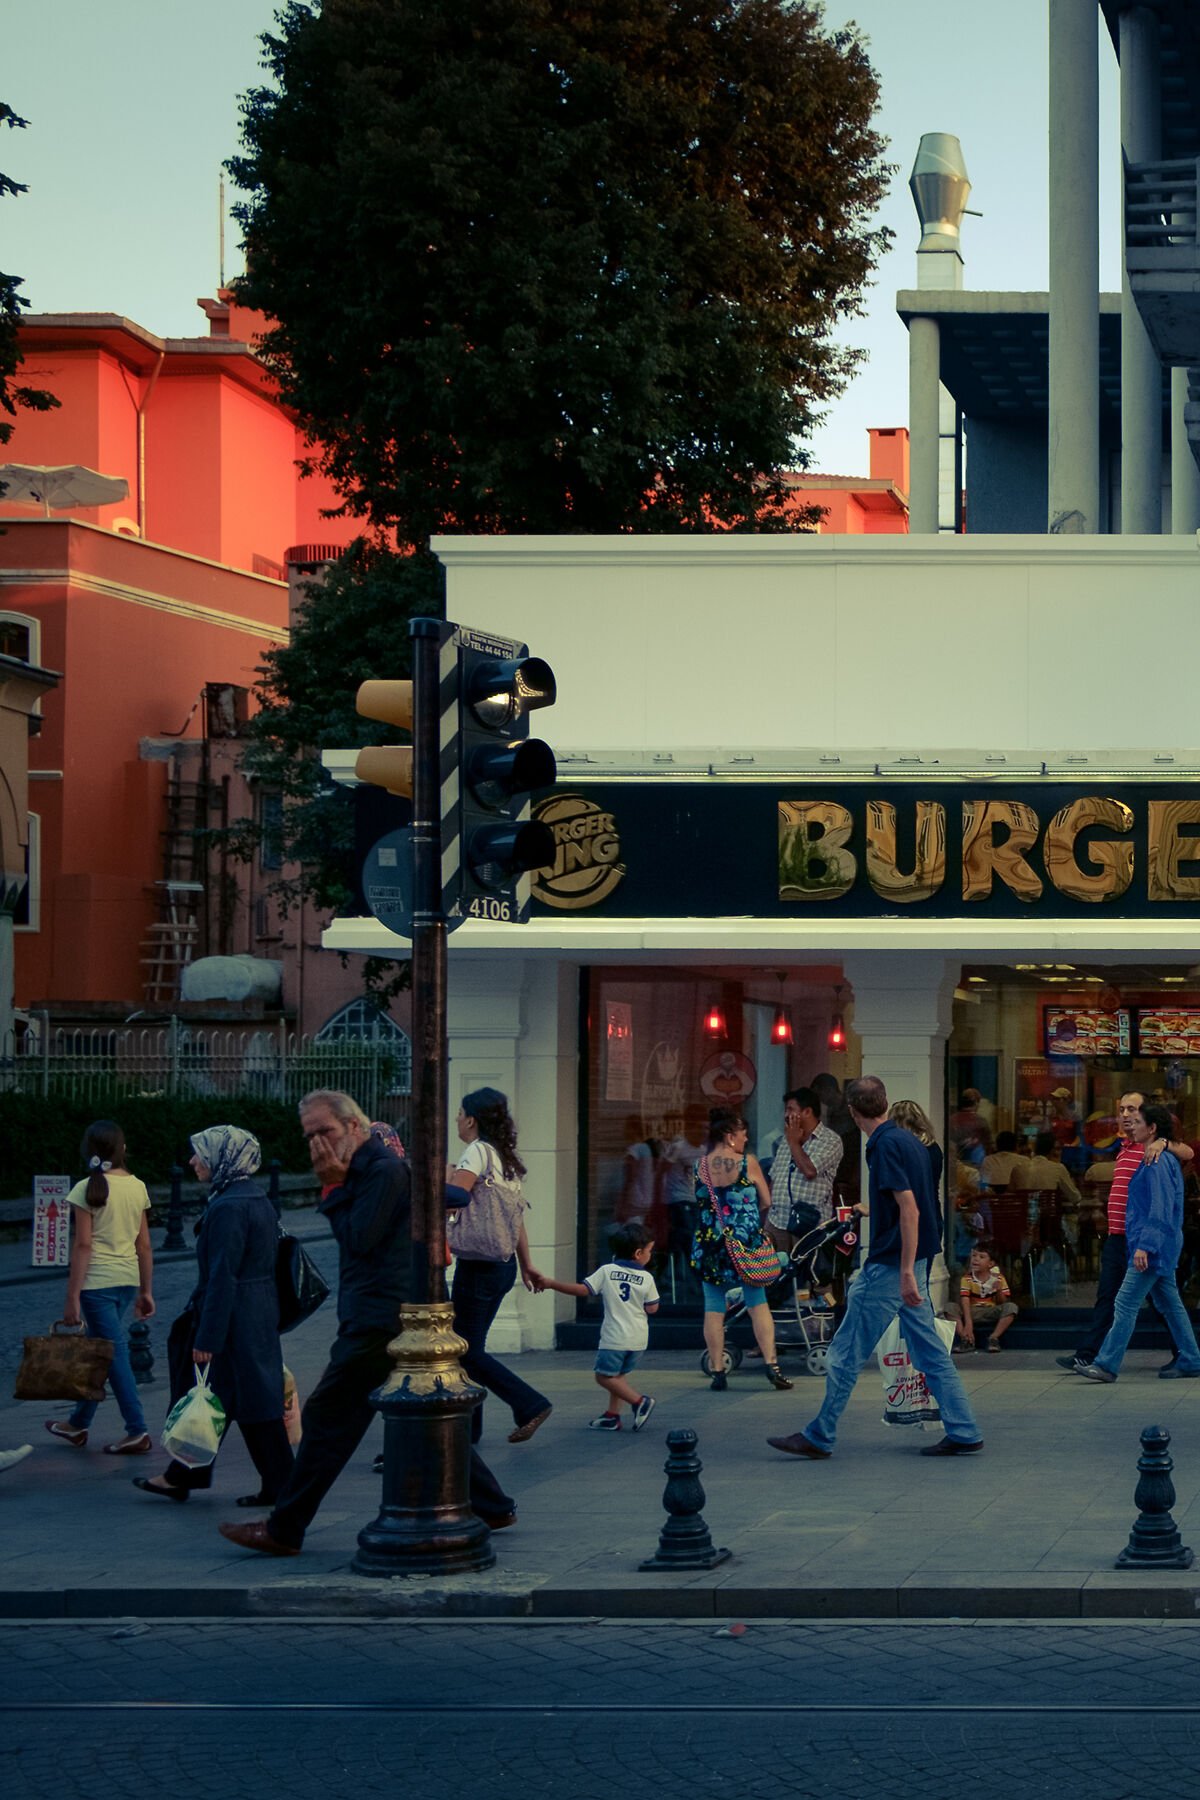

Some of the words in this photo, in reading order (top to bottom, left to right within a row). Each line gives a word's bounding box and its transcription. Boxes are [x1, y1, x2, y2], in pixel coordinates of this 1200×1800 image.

[469, 898, 510, 920] 4106
[60, 1200, 68, 1232] CHEAP
[36, 1199, 46, 1264] INTERNET
[619, 1282, 631, 1302] 3
